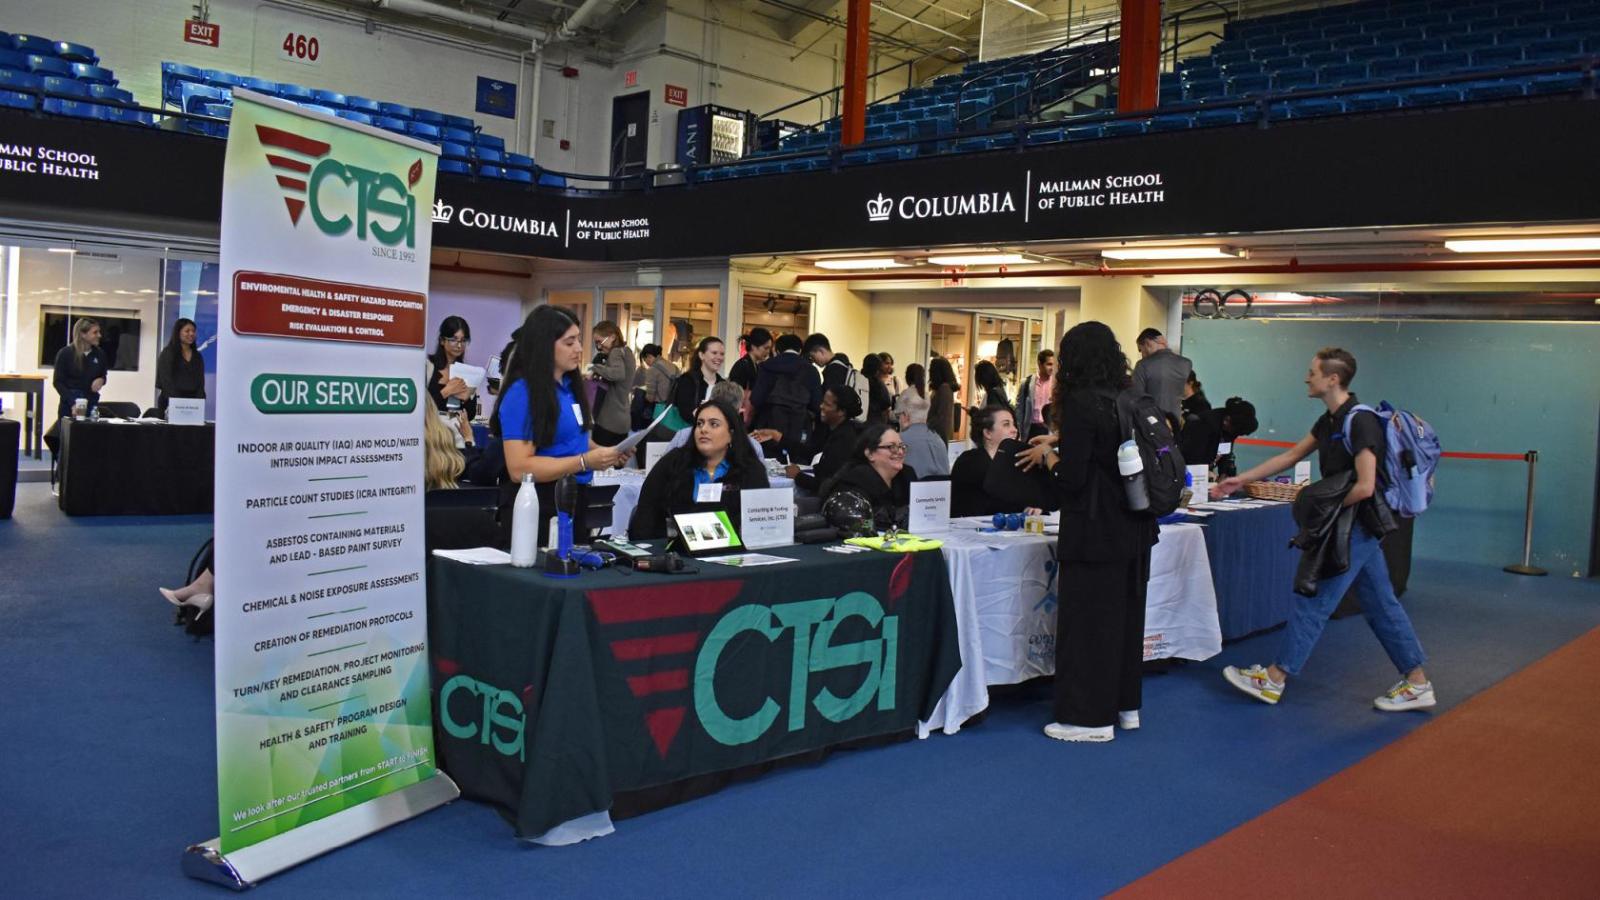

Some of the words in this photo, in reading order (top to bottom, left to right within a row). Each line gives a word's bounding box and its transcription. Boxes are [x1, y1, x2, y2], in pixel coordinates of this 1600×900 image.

[191, 24, 215, 38] EXIT
[283, 32, 319, 61] 460
[669, 88, 685, 100] EXIT
[37, 146, 98, 166] SCHOOL
[42, 162, 99, 180] HEALTH
[1039, 178, 1101, 194] MAILMAN
[1105, 173, 1163, 189] SCHOOL
[899, 191, 1016, 220] COLUMBIA
[1038, 198, 1055, 210] OF
[1059, 194, 1105, 208] PUBLIC
[1109, 190, 1165, 206] HEALTH
[458, 207, 559, 237] COLUMBIA
[576, 230, 591, 240] OF
[594, 230, 622, 240] PUBLIC
[623, 229, 650, 239] HEALTH
[577, 219, 620, 229] MAILMAN
[621, 218, 649, 228] SCHOOL
[372, 246, 398, 260] SINCE
[399, 251, 416, 263] 1992
[240, 281, 301, 297] ENVIROMENTAL
[302, 288, 326, 299] HEALTH
[327, 291, 333, 300] &
[334, 293, 359, 302] SAFETY
[360, 296, 387, 306] HAZARD
[387, 299, 424, 311] RECOGNITION
[281, 303, 321, 316] EMERGENCY
[322, 307, 328, 316] &
[328, 309, 361, 320] DISASTER
[362, 312, 394, 322] RESPONSE
[289, 321, 304, 330] RISK
[305, 323, 347, 334] EVALUATION
[349, 326, 354, 334] &
[355, 327, 385, 337] CONTROL
[262, 379, 309, 405] OUR
[315, 380, 409, 406] SERVICES
[237, 442, 278, 454] INDOOR
[279, 441, 293, 452] AIR
[294, 440, 330, 452] QUALITY
[332, 439, 354, 451] (IAQ)
[355, 439, 372, 449] AND
[373, 437, 420, 448] MOLD/WATER
[270, 456, 315, 469] INTRUSION
[315, 455, 348, 466] IMPACT
[349, 453, 403, 464] ASSESSMENTS
[246, 497, 288, 509] PARTICLE
[289, 493, 318, 505] COUNT
[320, 490, 355, 502] STUDIES
[356, 488, 378, 500] (ICRA
[378, 484, 416, 497] INTEGRITY)
[266, 534, 309, 549] ASBESTOS
[310, 528, 362, 543] CONTAINING
[363, 523, 405, 536] MATERIALS
[269, 552, 288, 565] AND
[289, 549, 311, 562] LEAD
[318, 545, 346, 558] BASED
[347, 542, 371, 554] PAINT
[372, 538, 403, 550] SURVEY
[242, 598, 289, 613] CHEMICAL
[290, 594, 297, 604] &
[299, 588, 325, 602] NOISE
[326, 581, 369, 597] EXPOSURE
[370, 572, 419, 589] ASSESSMENTS
[253, 634, 297, 652] CREATION
[298, 631, 311, 642] OF
[312, 619, 368, 639] REMEDIATION
[368, 610, 413, 627] PROTOCOLS
[233, 678, 281, 698] TURN/KEY
[282, 664, 342, 685] REMEDIATION,
[343, 653, 379, 671] PROJECT
[380, 642, 425, 662] MONITORING
[279, 688, 299, 702] AND
[300, 675, 350, 696] CLEARANCE
[351, 665, 392, 684] SAMPLING
[259, 730, 293, 750] HEALTH
[294, 729, 303, 740] &
[303, 719, 335, 737] SAFETY
[337, 707, 378, 727] PROGRAM
[379, 698, 408, 714] DESIGN
[308, 737, 328, 751] AND
[329, 724, 368, 744] TRAINING
[232, 810, 247, 822] We
[248, 803, 266, 818] look
[266, 796, 286, 811] after
[301, 781, 328, 798] trusted
[328, 770, 358, 791] partners
[360, 765, 376, 777] from
[377, 757, 399, 770] START
